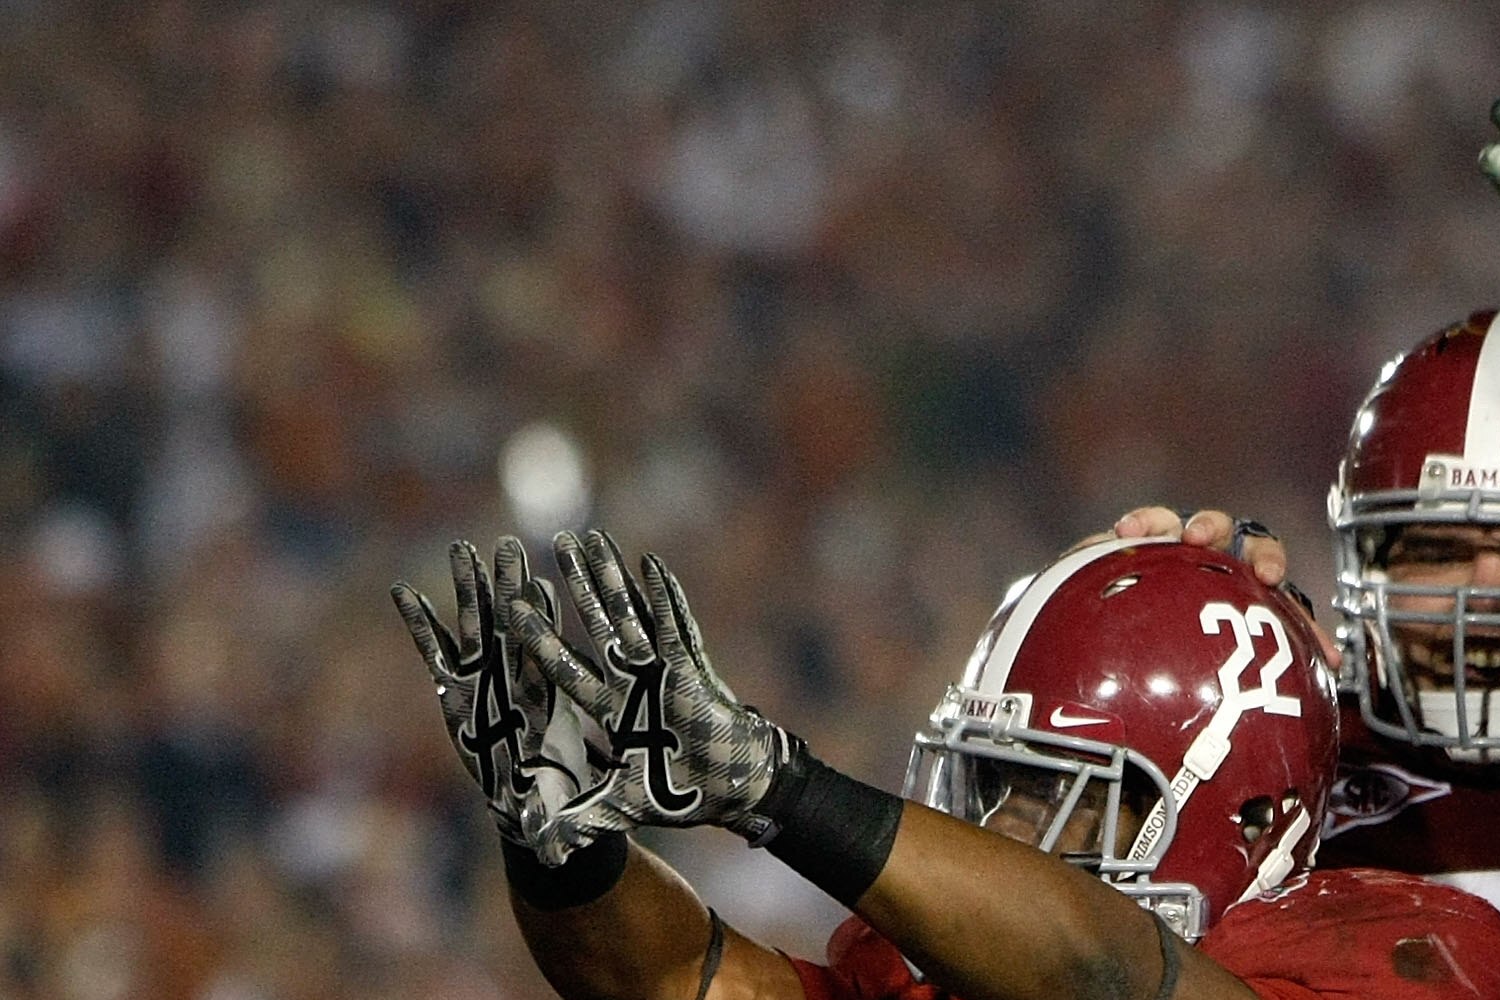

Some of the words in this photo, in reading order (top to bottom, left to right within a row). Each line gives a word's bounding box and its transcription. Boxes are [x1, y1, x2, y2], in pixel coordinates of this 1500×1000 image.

[1199, 602, 1301, 717] 22
[590, 639, 703, 817] A
[1132, 802, 1167, 861] RIMSON
